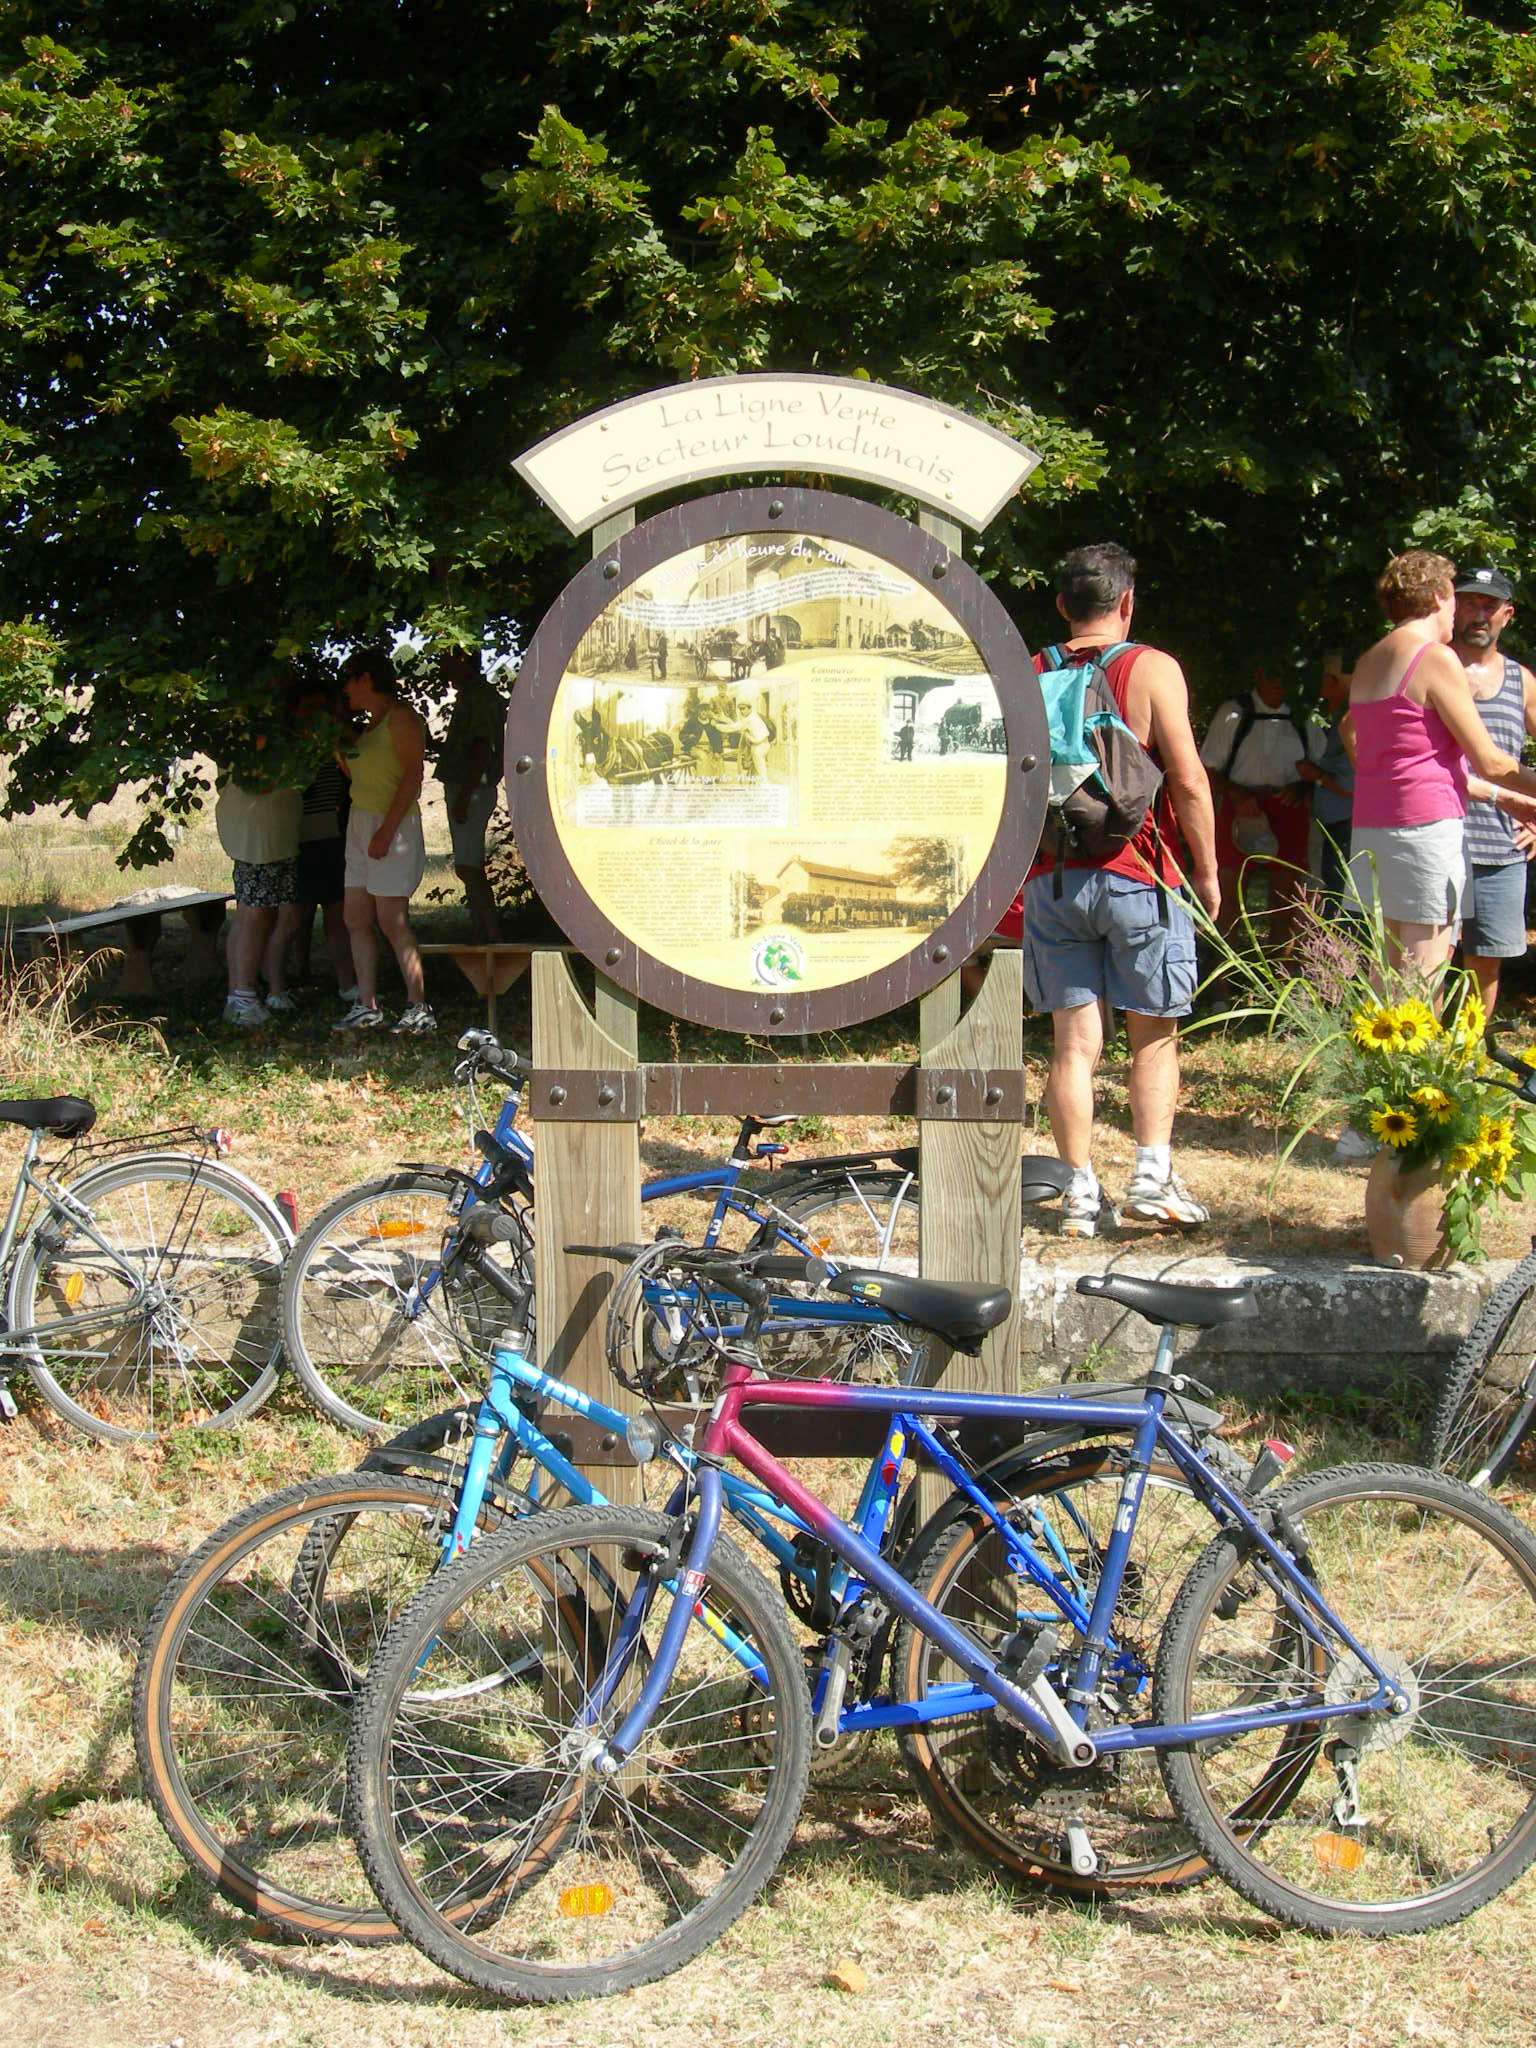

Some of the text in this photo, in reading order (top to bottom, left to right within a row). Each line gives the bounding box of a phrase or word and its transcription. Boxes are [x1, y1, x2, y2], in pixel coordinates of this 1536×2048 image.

[659, 390, 896, 429] La Ligne Verte
[602, 421, 955, 487] Secteur Loudunais
[726, 541, 786, 560] l'heure
[790, 537, 812, 558] du
[817, 547, 849, 567] rail
[709, 1218, 722, 1236] 3
